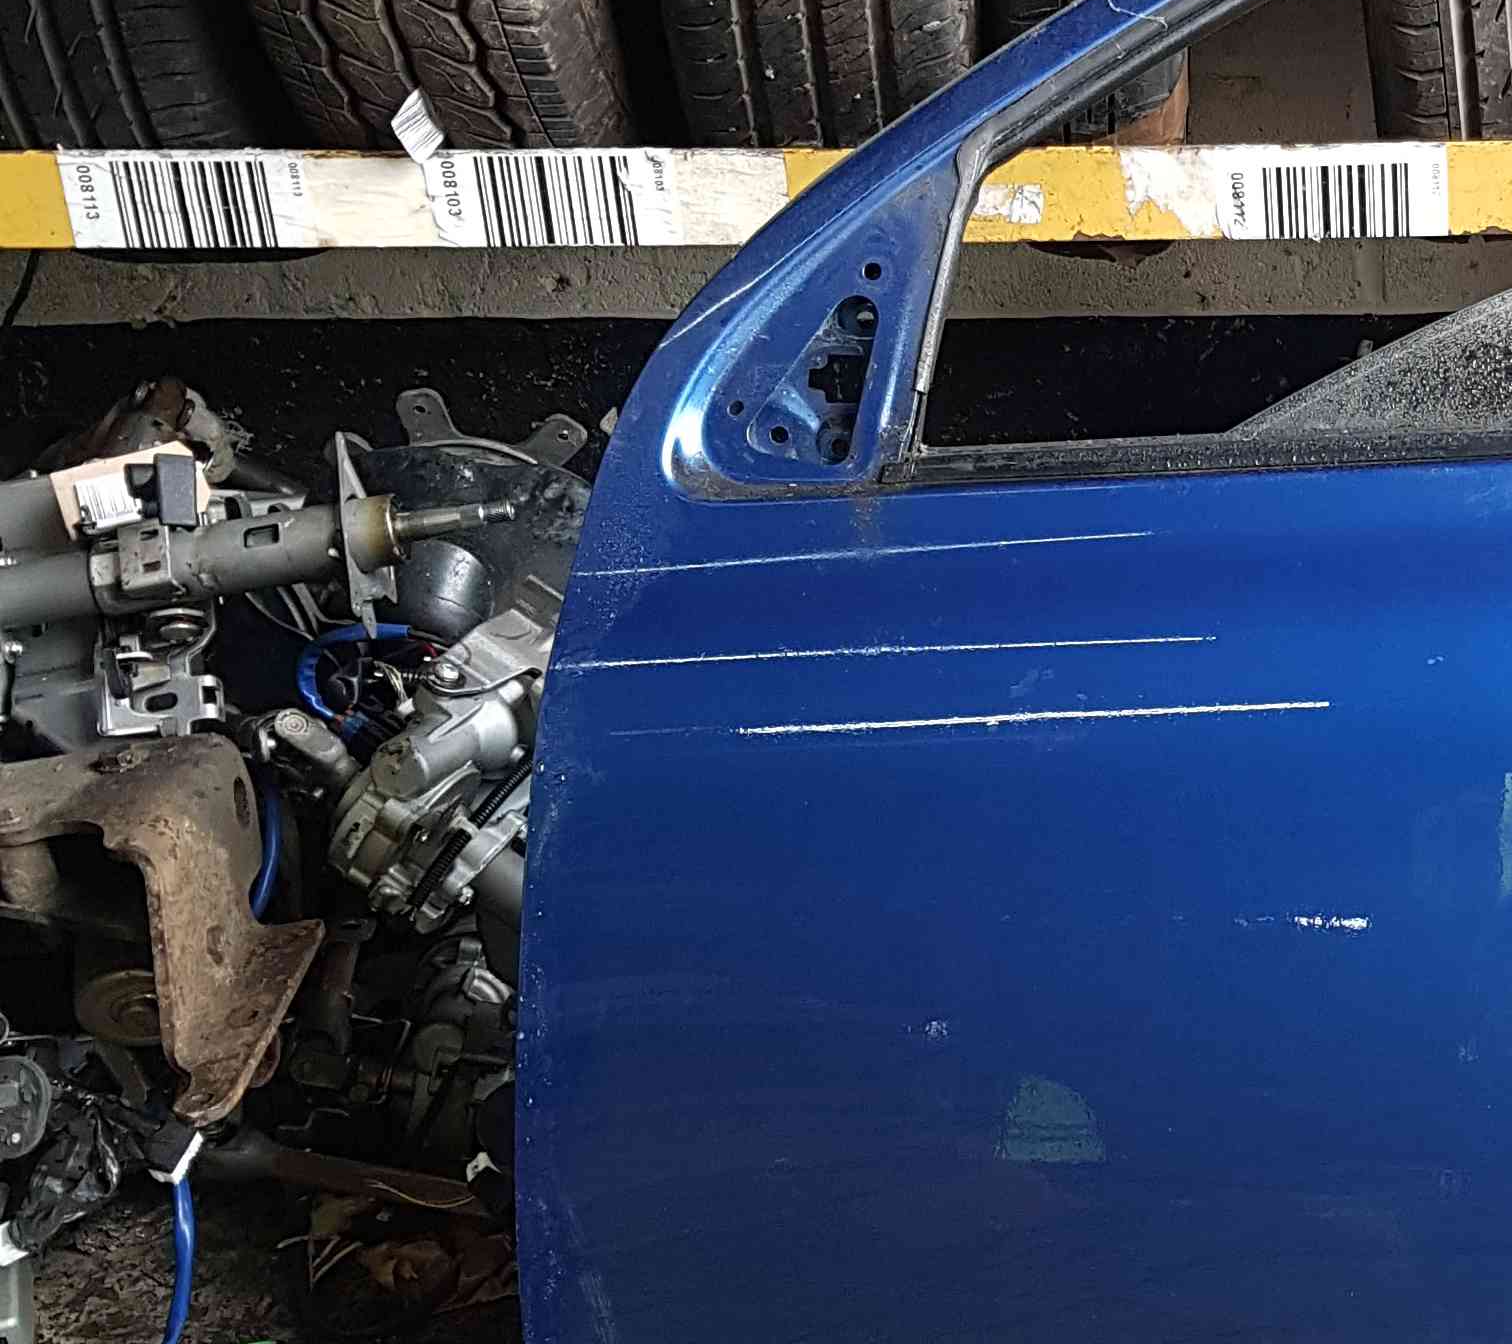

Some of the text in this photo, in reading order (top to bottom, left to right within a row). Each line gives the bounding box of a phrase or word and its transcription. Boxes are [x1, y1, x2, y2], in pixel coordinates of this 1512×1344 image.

[76, 164, 100, 220] 008113
[287, 162, 303, 197] 008113
[440, 160, 462, 217] 008103
